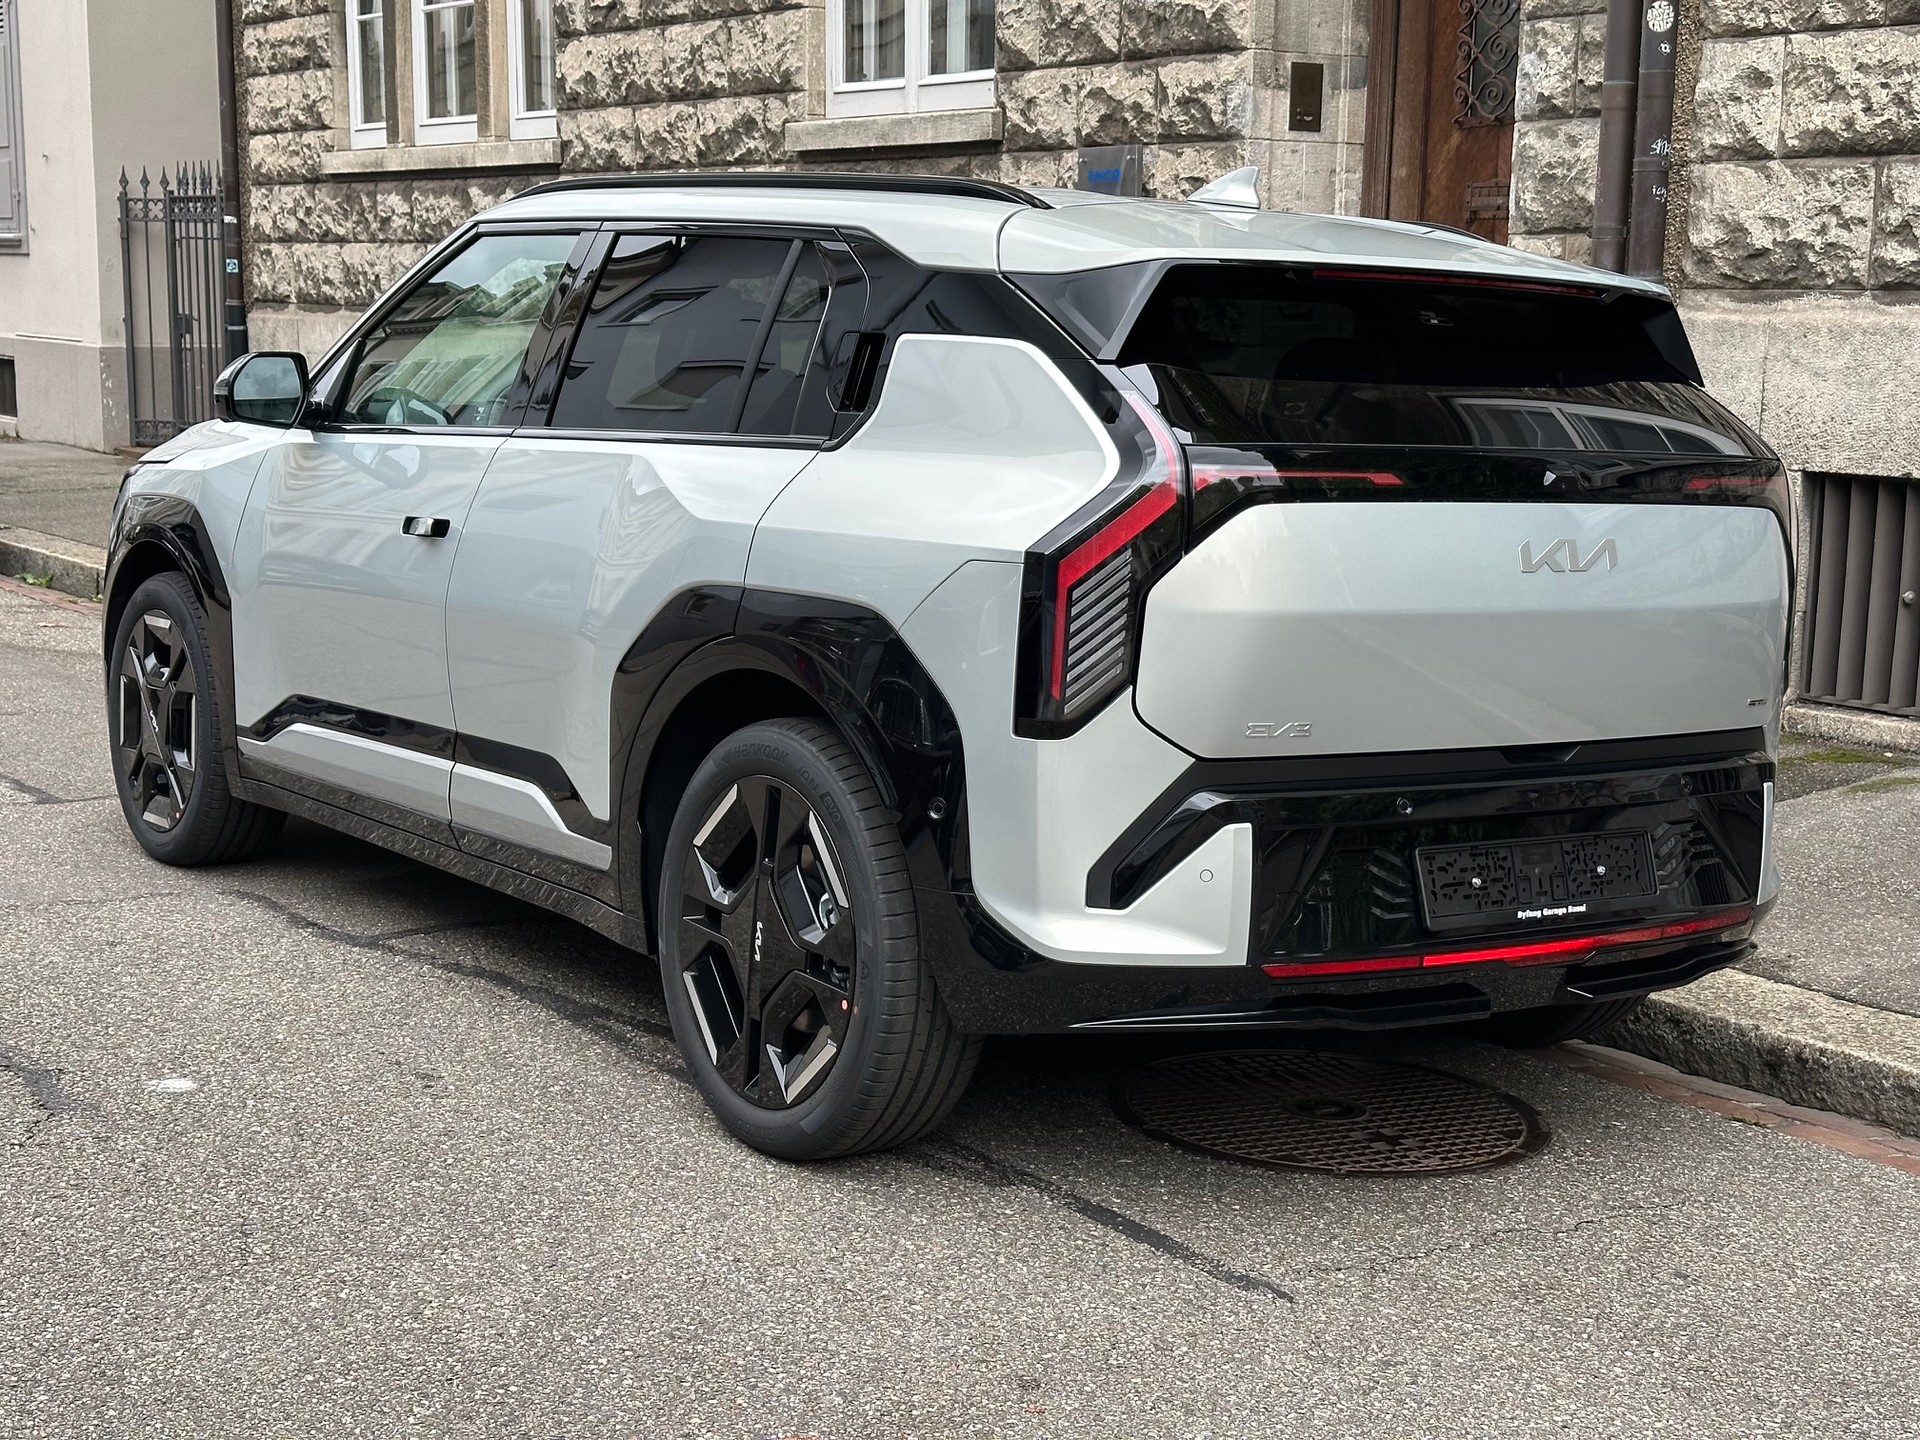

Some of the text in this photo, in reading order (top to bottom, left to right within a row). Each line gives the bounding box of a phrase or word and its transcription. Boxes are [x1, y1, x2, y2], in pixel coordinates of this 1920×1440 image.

[1647, 5, 1674, 21] BASEL
[1518, 538, 1618, 573] KIA
[1245, 722, 1312, 738] EV3
[1543, 907, 1567, 915] Garage
